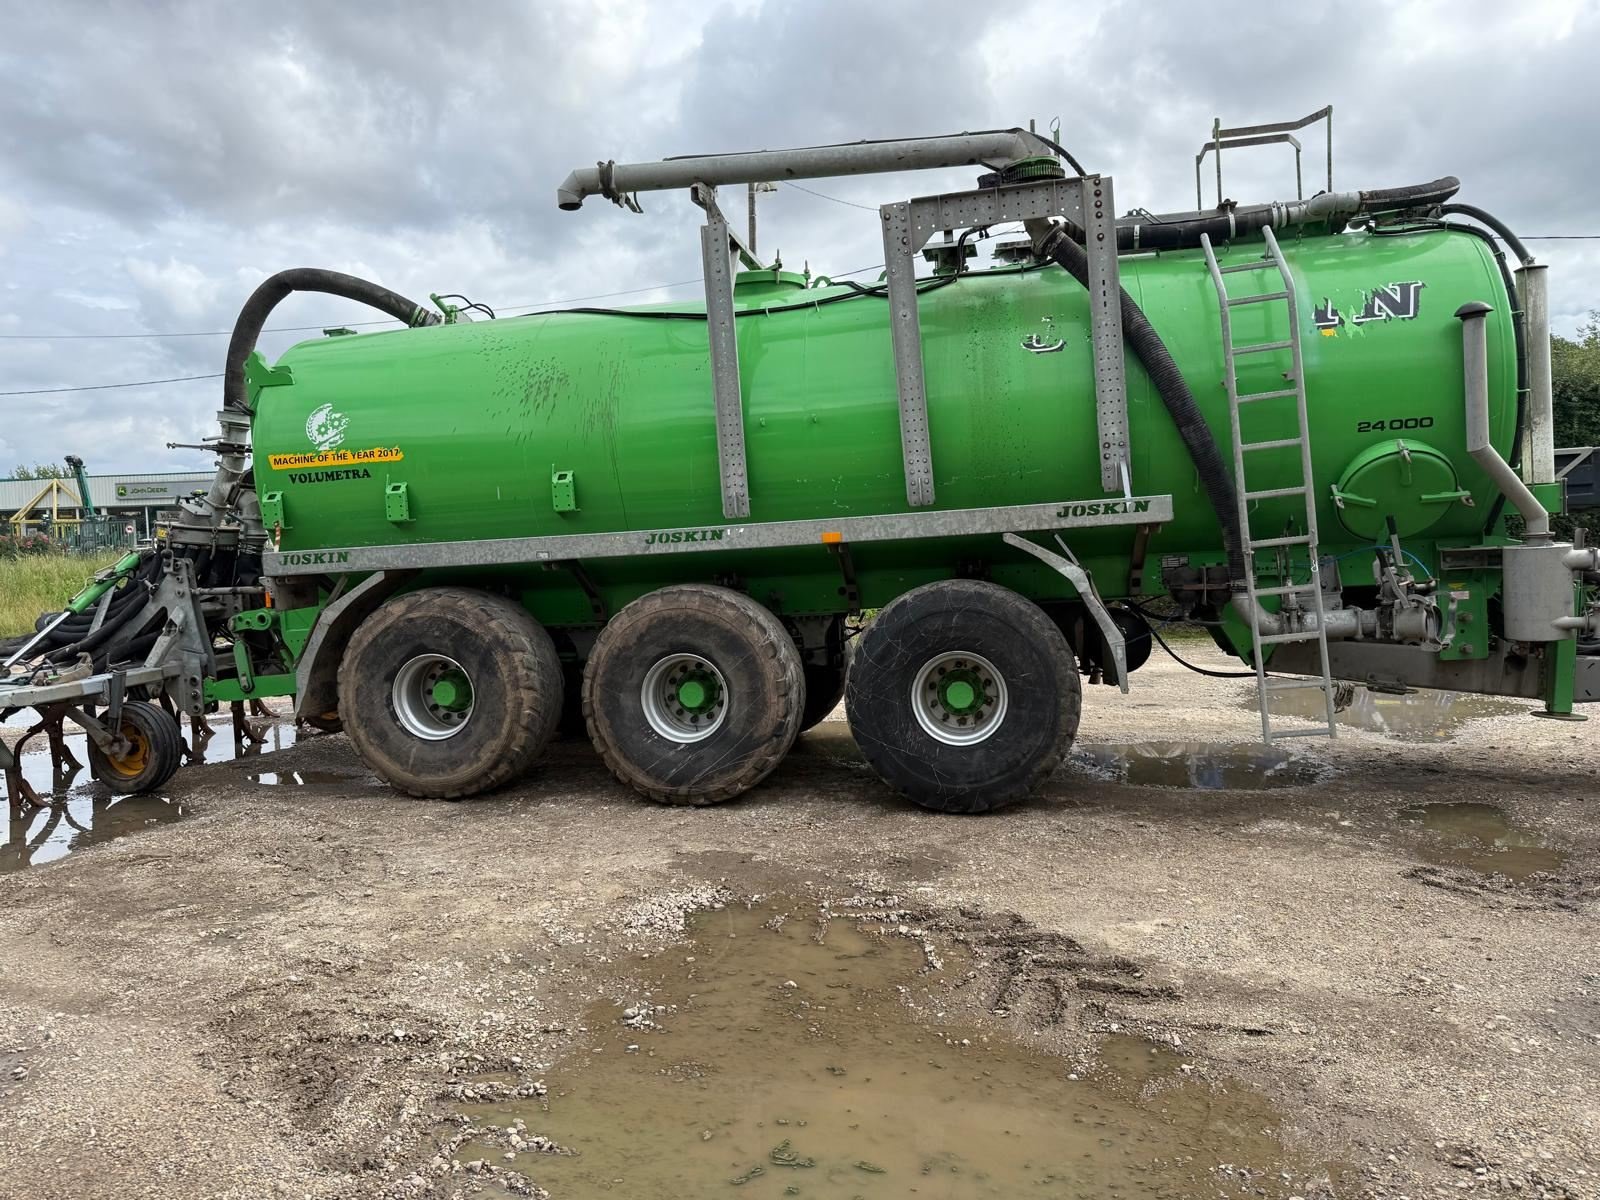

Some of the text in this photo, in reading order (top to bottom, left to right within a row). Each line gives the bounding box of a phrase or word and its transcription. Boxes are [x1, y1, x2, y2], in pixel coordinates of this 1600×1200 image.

[273, 448, 400, 466] MACHINE OF THE YEAR 2017
[289, 468, 372, 485] VOLUMETRA
[130, 486, 168, 495] JOHN DEERE
[1056, 500, 1151, 518] JOSKIN
[645, 529, 725, 545] JOSKIN
[279, 551, 350, 566] JOSKIN
